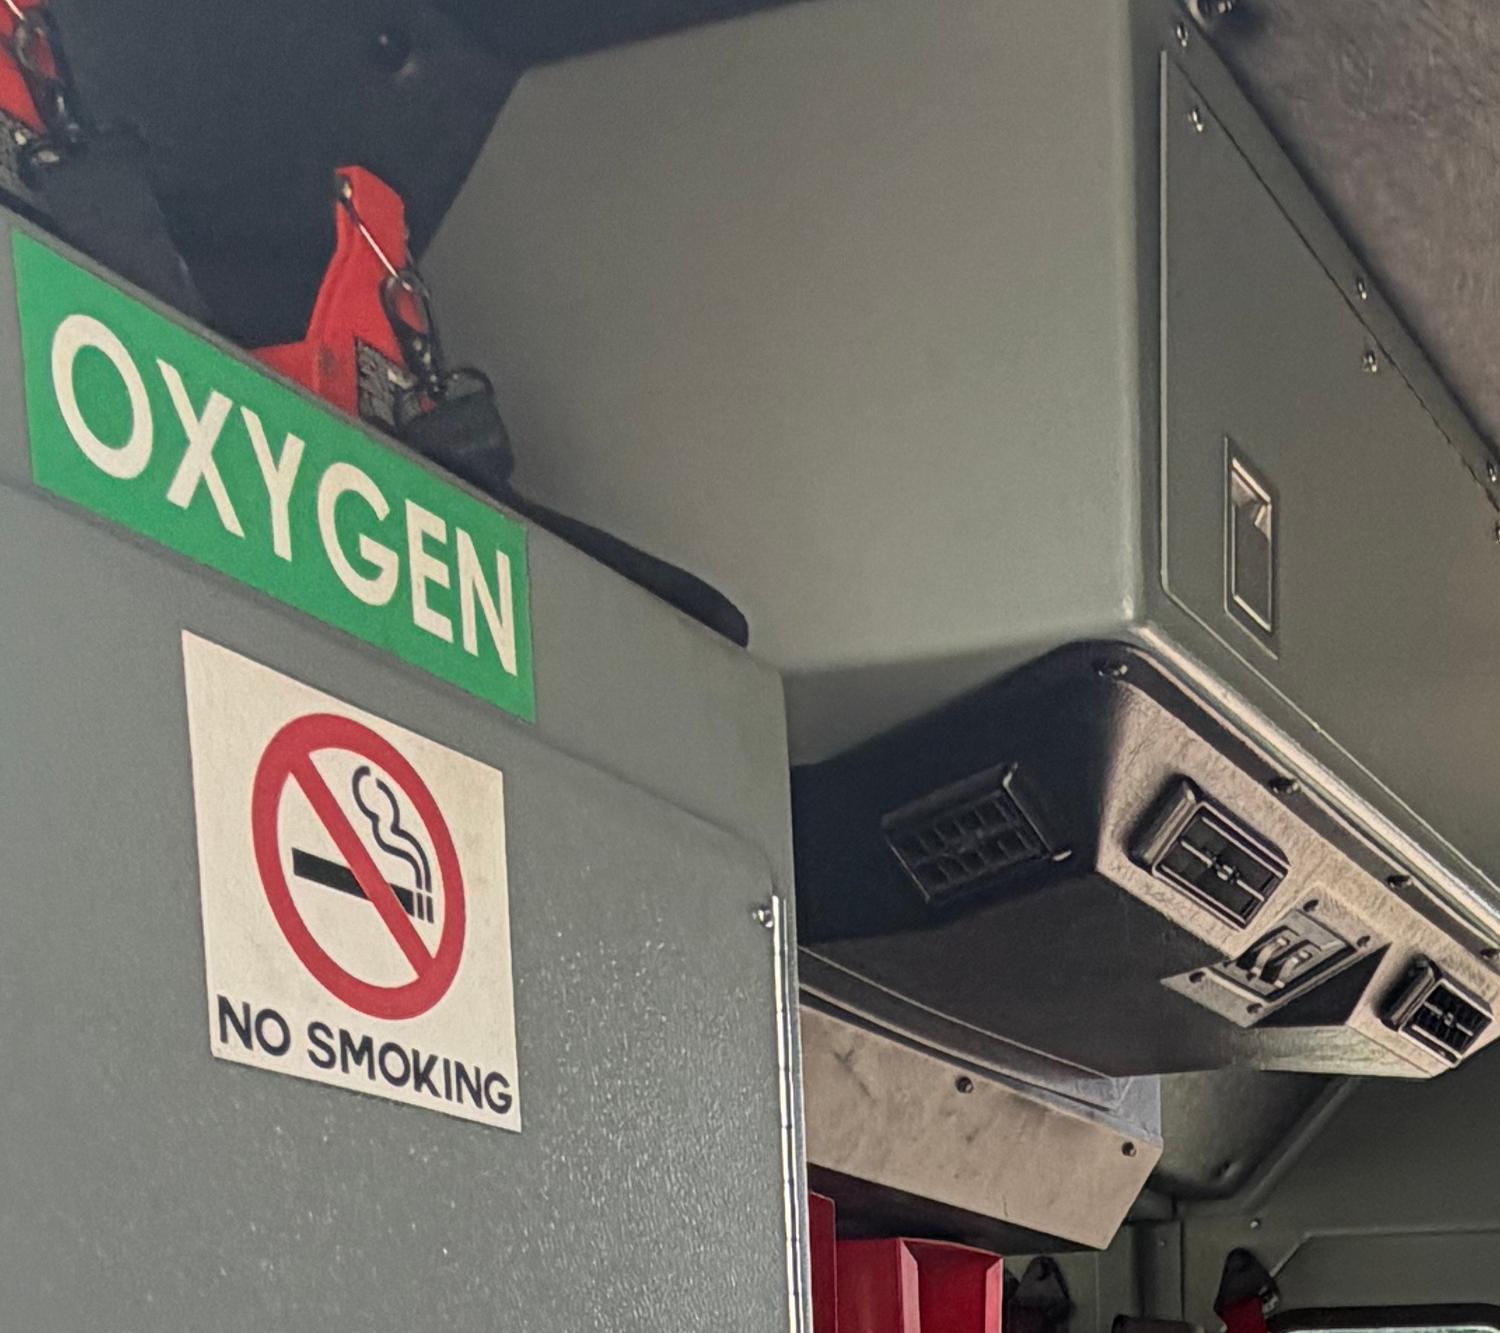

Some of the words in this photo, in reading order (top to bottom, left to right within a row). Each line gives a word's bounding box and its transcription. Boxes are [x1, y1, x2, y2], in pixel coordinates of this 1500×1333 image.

[51, 314, 518, 676] OXYGEN
[217, 994, 292, 1057] NO
[307, 1021, 513, 1115] SMOKING
